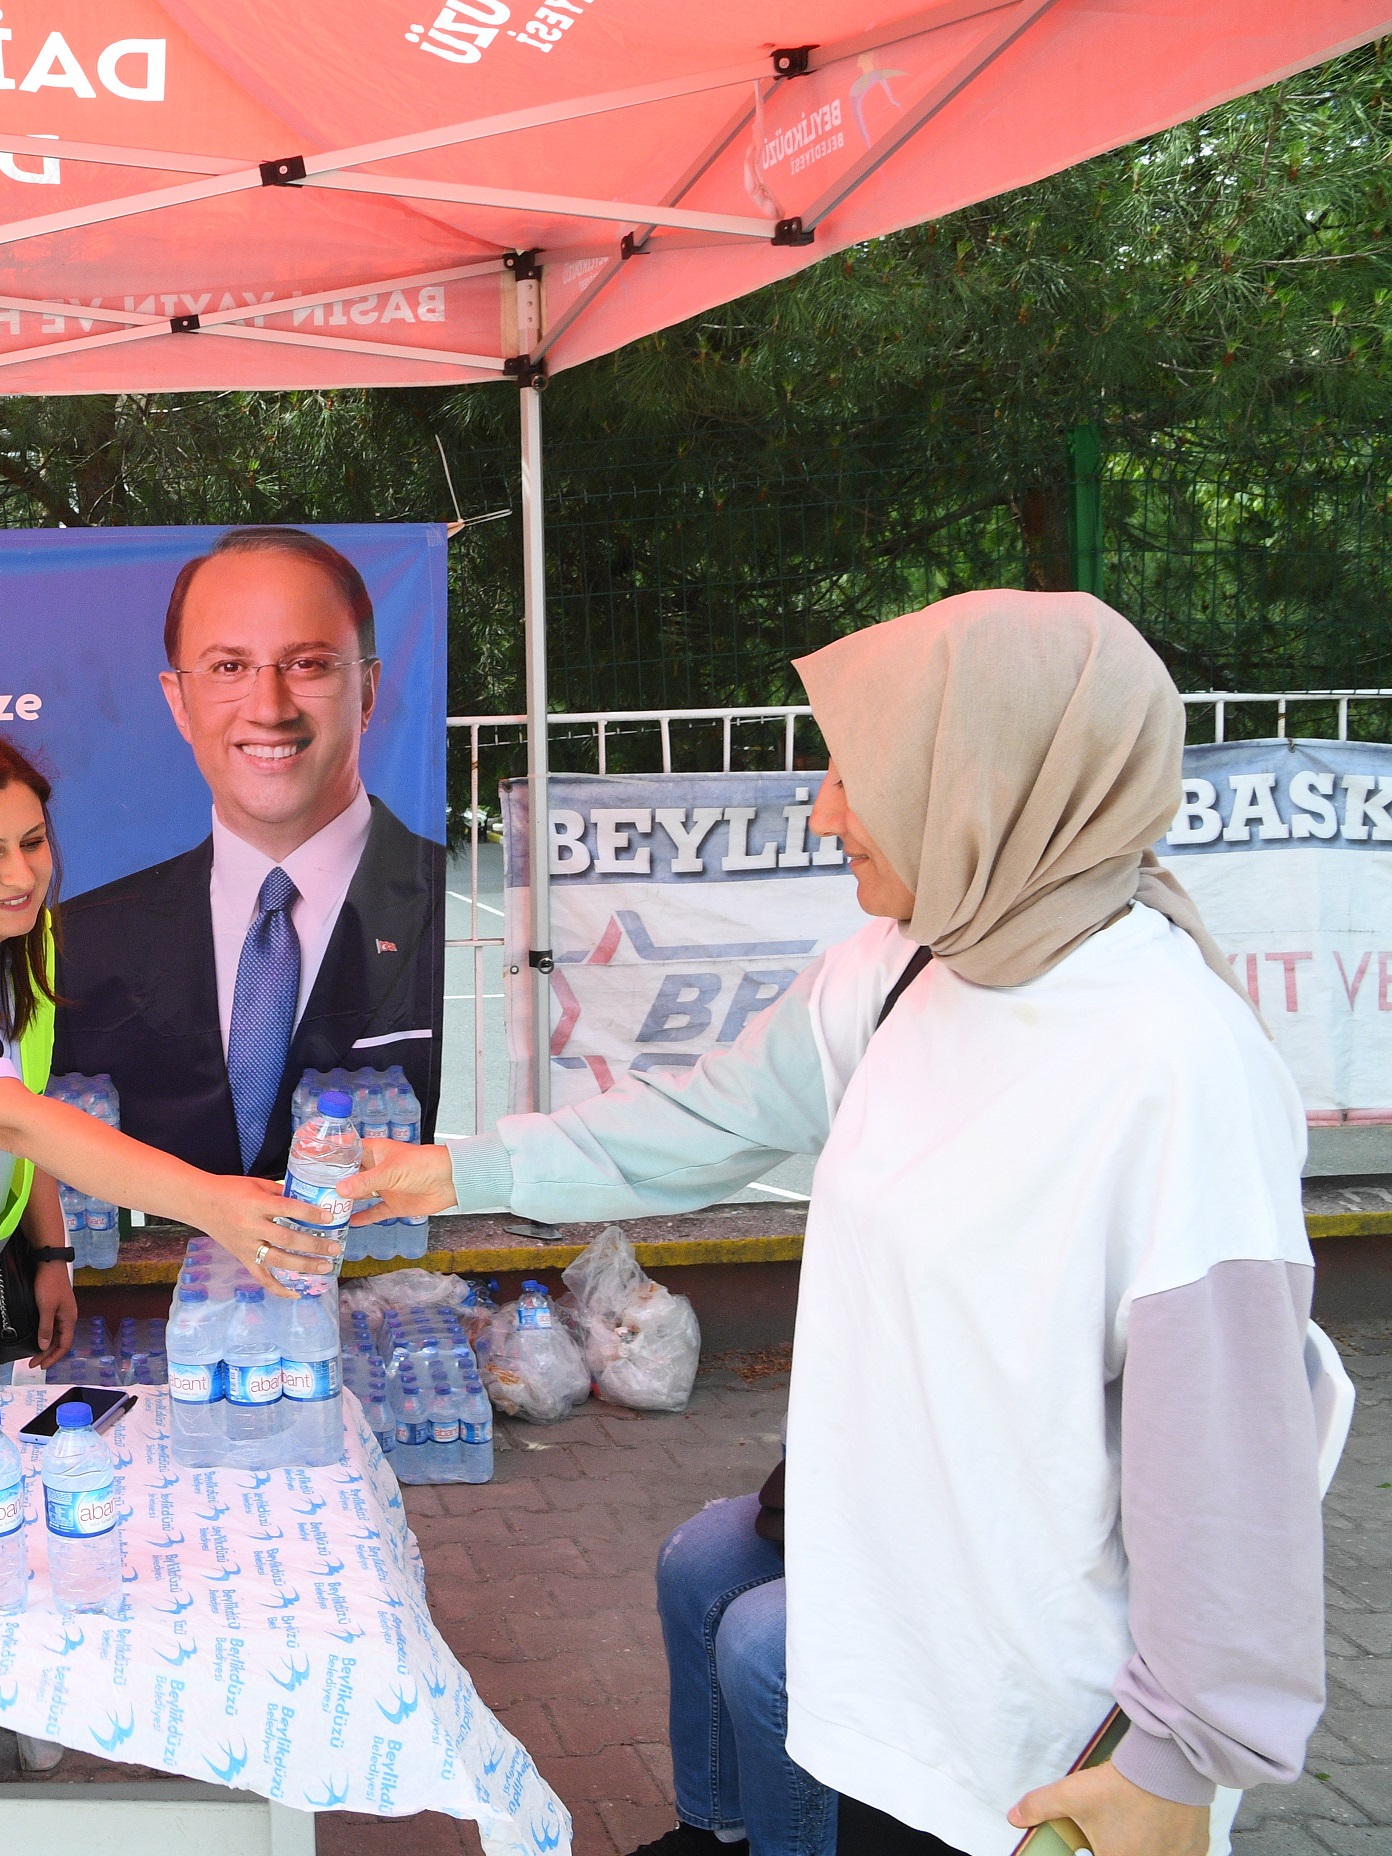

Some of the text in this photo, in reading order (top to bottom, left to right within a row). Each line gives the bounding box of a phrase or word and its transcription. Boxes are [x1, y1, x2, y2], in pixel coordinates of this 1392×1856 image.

[549, 786, 844, 876] BEYLİ
[224, 1637, 246, 1717] Beylikdüzü
[321, 1653, 339, 1714] Belediyesi
[329, 1656, 357, 1750] Beylikdüzü
[163, 1678, 186, 1767] Beylikdüzü
[269, 1704, 296, 1800] Beylikdüzü
[364, 1735, 385, 1803] Belediyesi
